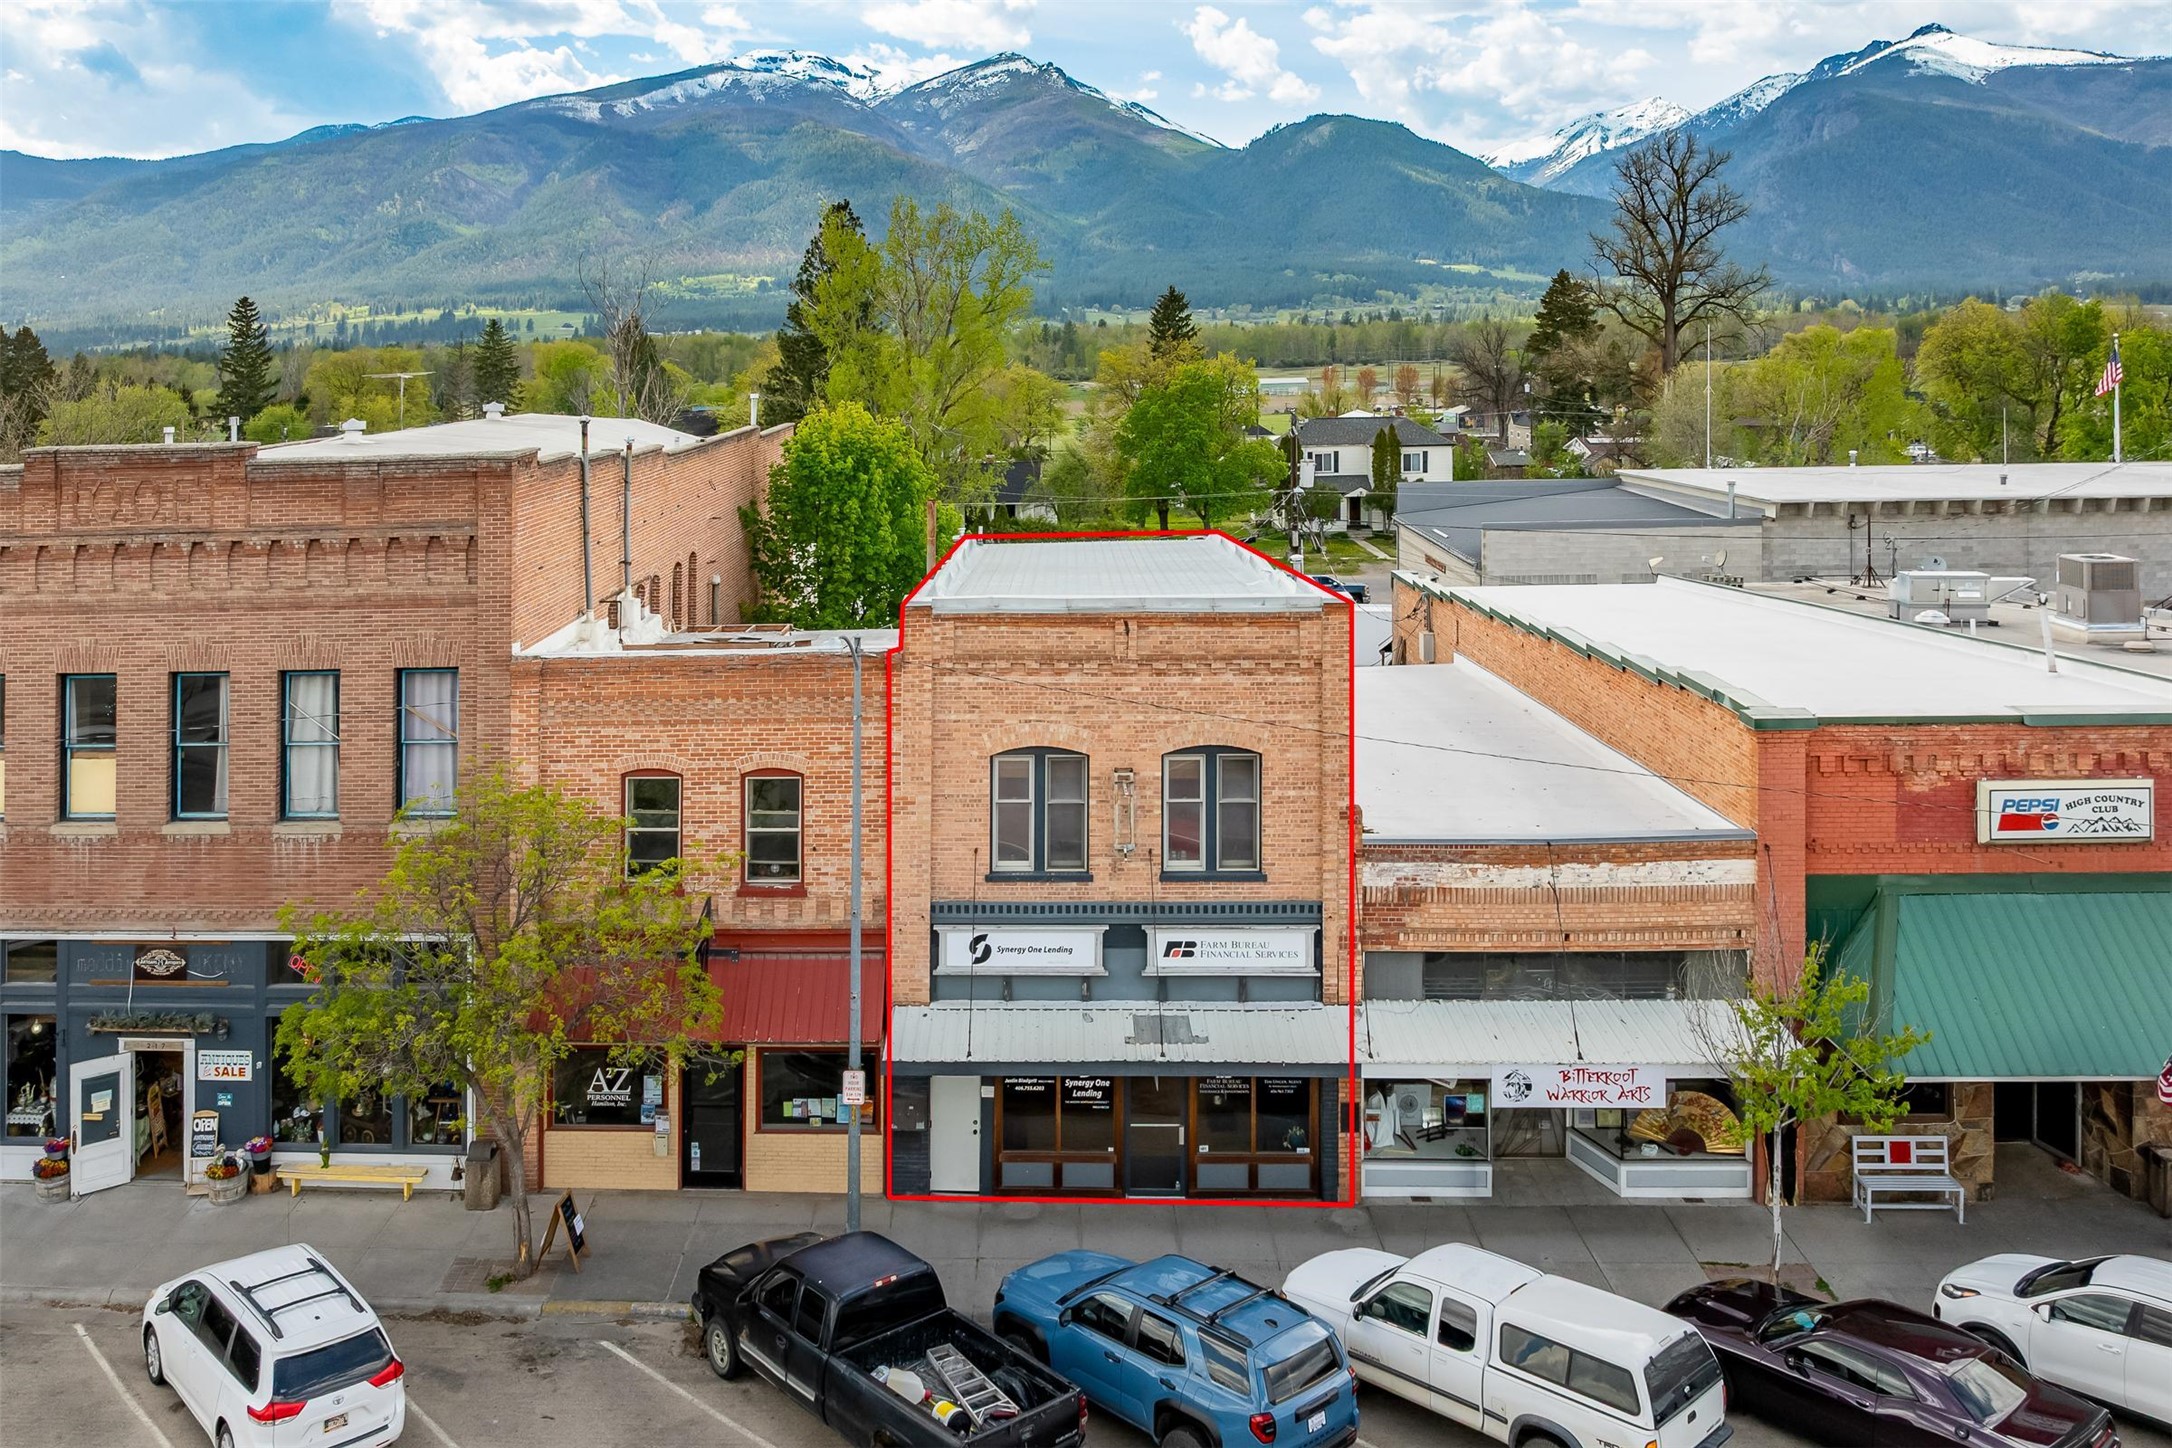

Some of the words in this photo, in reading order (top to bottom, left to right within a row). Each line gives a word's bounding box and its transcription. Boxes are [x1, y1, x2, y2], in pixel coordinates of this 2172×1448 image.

[2002, 798, 2060, 812] PEPSI
[2065, 796, 2091, 810] HIGH
[2094, 795, 2145, 808] COUNTRY
[996, 945, 1026, 955] Synergy
[1043, 946, 1073, 955] Lending
[1200, 941, 1227, 949] FARM
[1231, 941, 1270, 949] BUREAU
[1200, 950, 1251, 958] FINANCIAL
[1255, 950, 1299, 958] SERVICES
[214, 1067, 246, 1077] SALE
[1065, 1079, 1094, 1088] Synergy
[1095, 1079, 1110, 1087] One
[1072, 1089, 1102, 1099] Lending
[1546, 1084, 1613, 1103] WARRIOR
[1618, 1085, 1651, 1103] ARTS
[193, 1118, 217, 1132] OPEN
